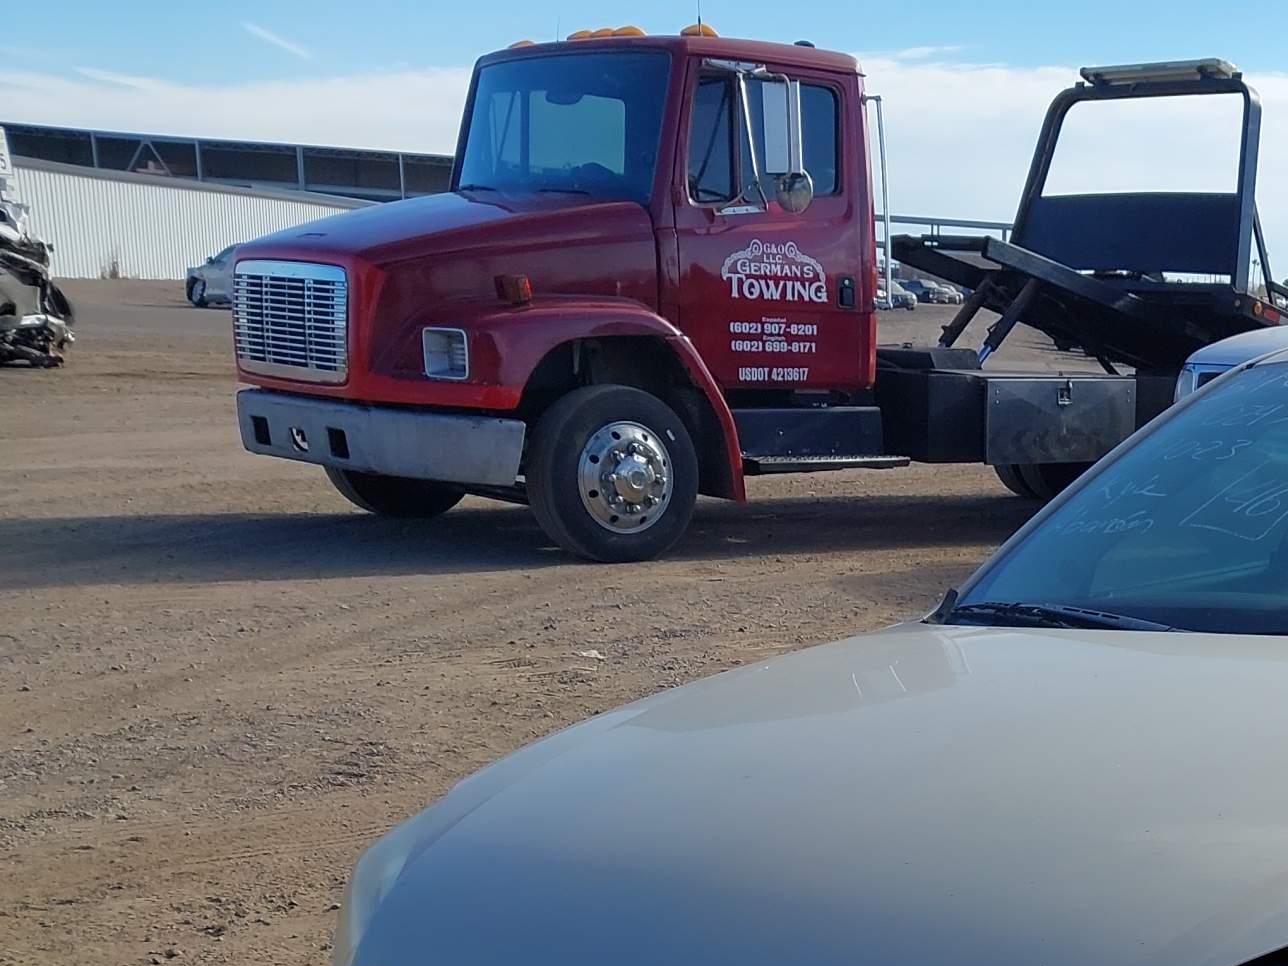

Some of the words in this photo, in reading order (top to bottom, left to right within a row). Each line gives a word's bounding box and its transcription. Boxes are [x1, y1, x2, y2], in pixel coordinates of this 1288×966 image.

[725, 273, 828, 302] TOWING
[729, 321, 762, 334] (602)
[731, 340, 762, 352] (602)
[738, 367, 769, 381] USDOT
[771, 367, 809, 381] 4213617
